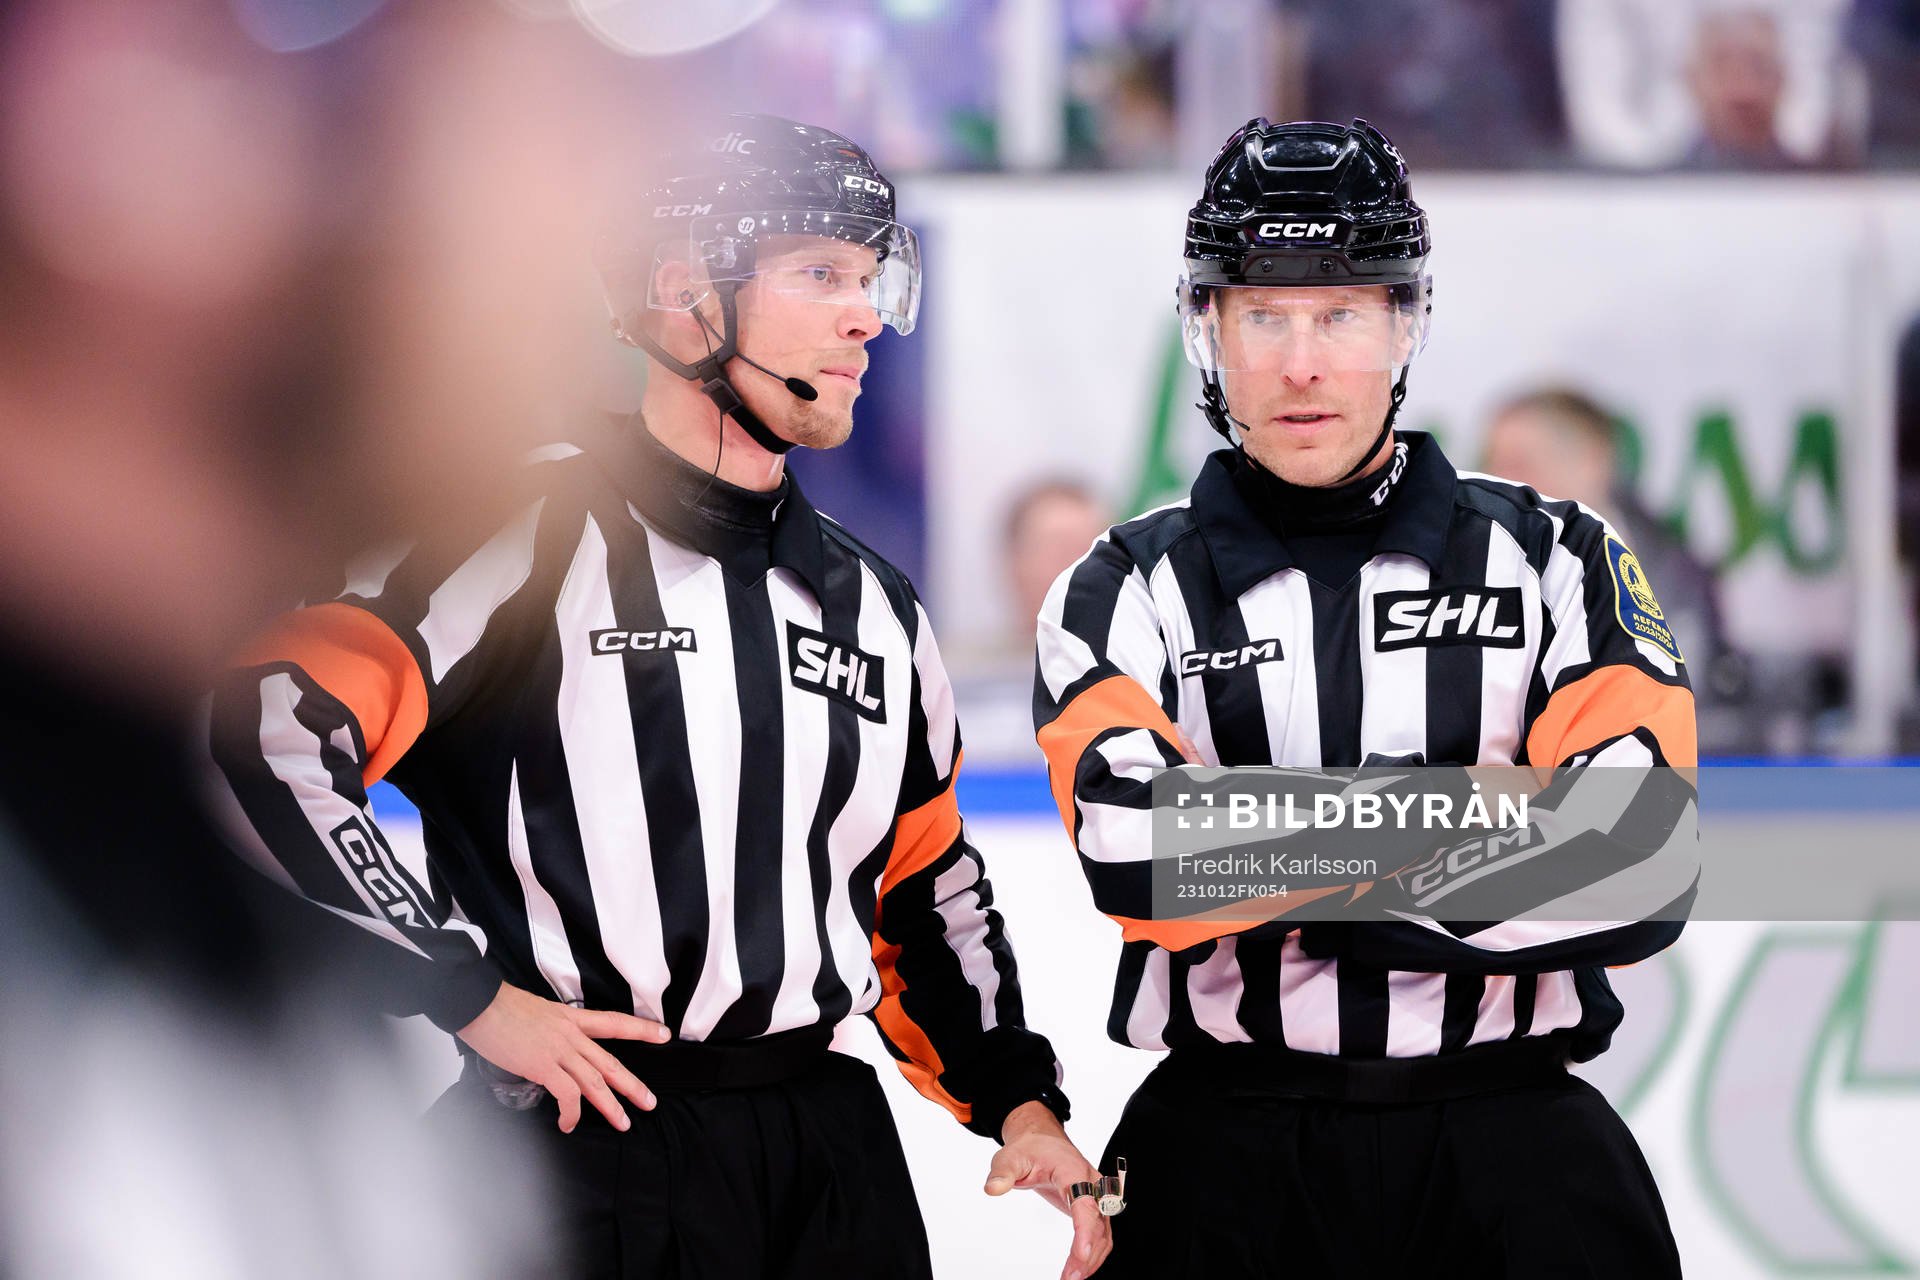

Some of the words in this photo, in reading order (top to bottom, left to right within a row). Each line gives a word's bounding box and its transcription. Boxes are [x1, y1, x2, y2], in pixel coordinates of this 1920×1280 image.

[843, 174, 890, 200] CCM
[652, 203, 713, 218] CCM
[1258, 223, 1337, 238] CCM
[1380, 593, 1519, 643] SHL
[596, 630, 692, 652] CCM
[1181, 641, 1277, 674] CCM
[793, 636, 881, 711] SHL
[1411, 827, 1531, 896] CCM
